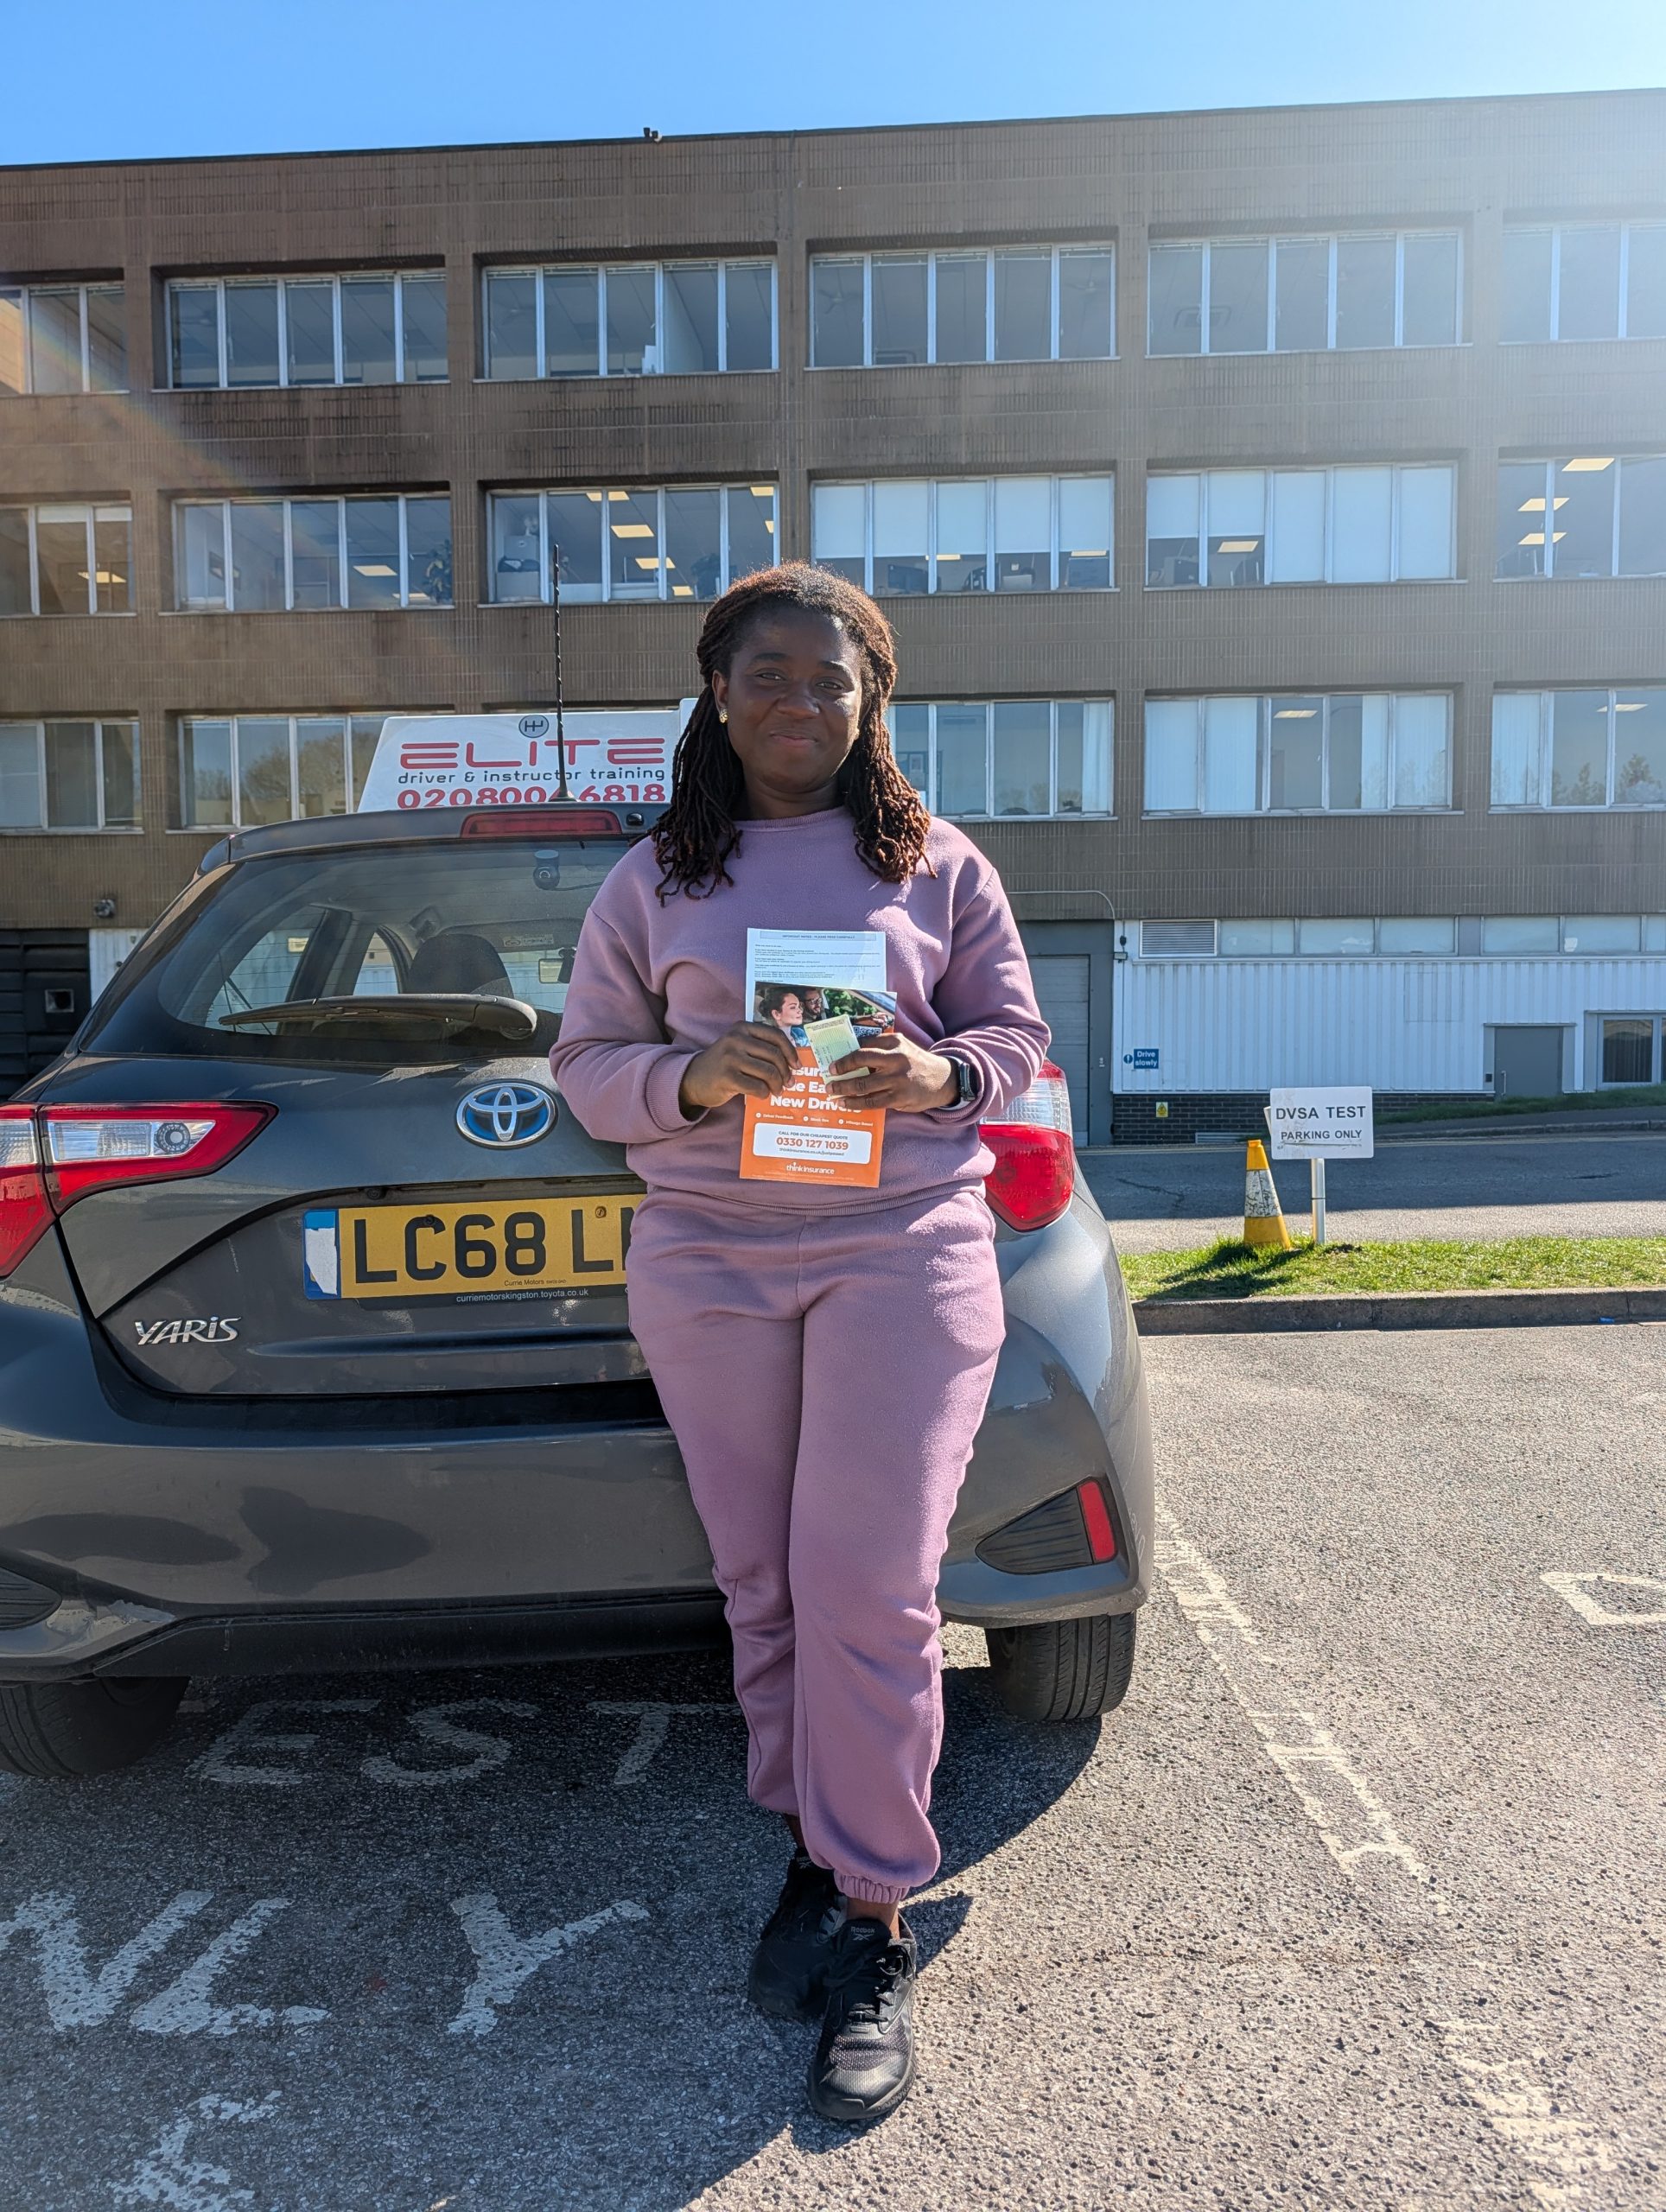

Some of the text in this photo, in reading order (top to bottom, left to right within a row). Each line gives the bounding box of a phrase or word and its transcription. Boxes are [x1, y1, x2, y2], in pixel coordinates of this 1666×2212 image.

[400, 738, 665, 769] ELITE
[397, 767, 665, 784] driver & instructor training
[808, 1081, 827, 1094] Ea
[771, 1096, 804, 1107] New
[1276, 1106, 1366, 1120] DVSA TEST
[1281, 1129, 1363, 1140] PARKING ONLY
[776, 1137, 849, 1150] 0330 127 1039
[353, 1211, 547, 1284] LC68
[456, 1287, 588, 1303] curriemotorskingston.toyota.co.uk
[176, 1698, 741, 1787] EST
